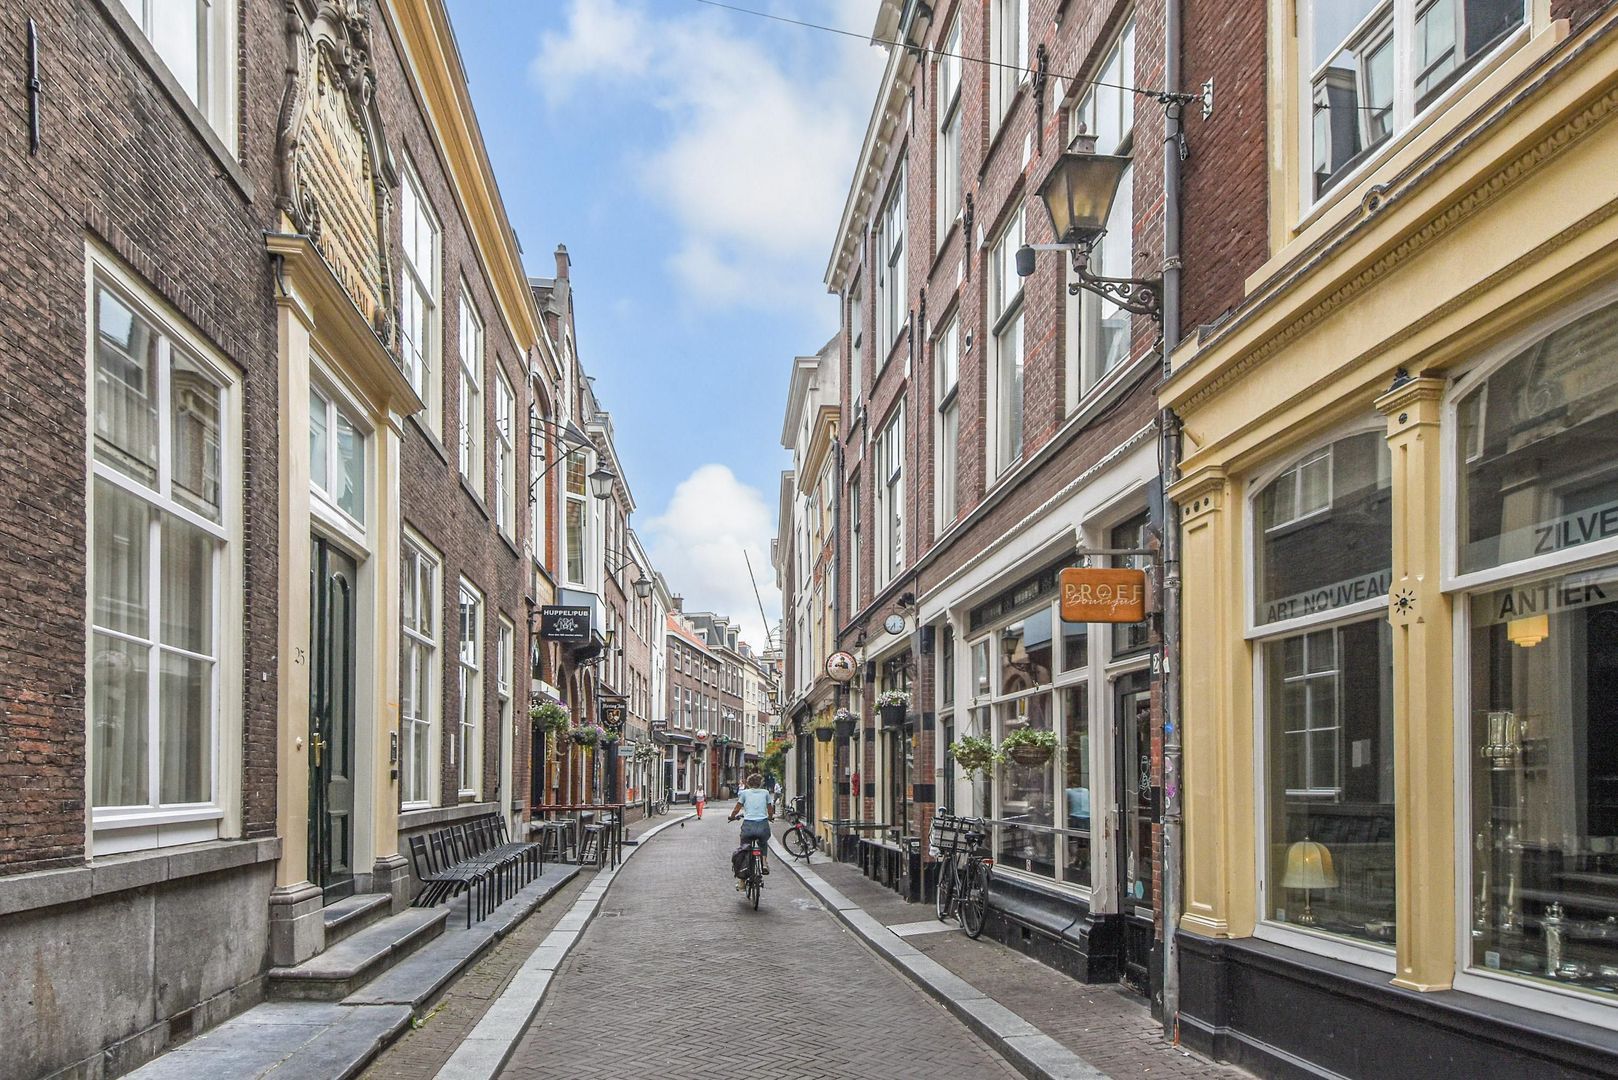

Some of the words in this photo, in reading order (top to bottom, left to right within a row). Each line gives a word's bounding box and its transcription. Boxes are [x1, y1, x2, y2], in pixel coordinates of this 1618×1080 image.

[1065, 583, 1143, 599] PROEF
[1267, 601, 1296, 623] ART
[1304, 573, 1391, 613] NOUVEAU
[1499, 575, 1607, 619] ANTIEK
